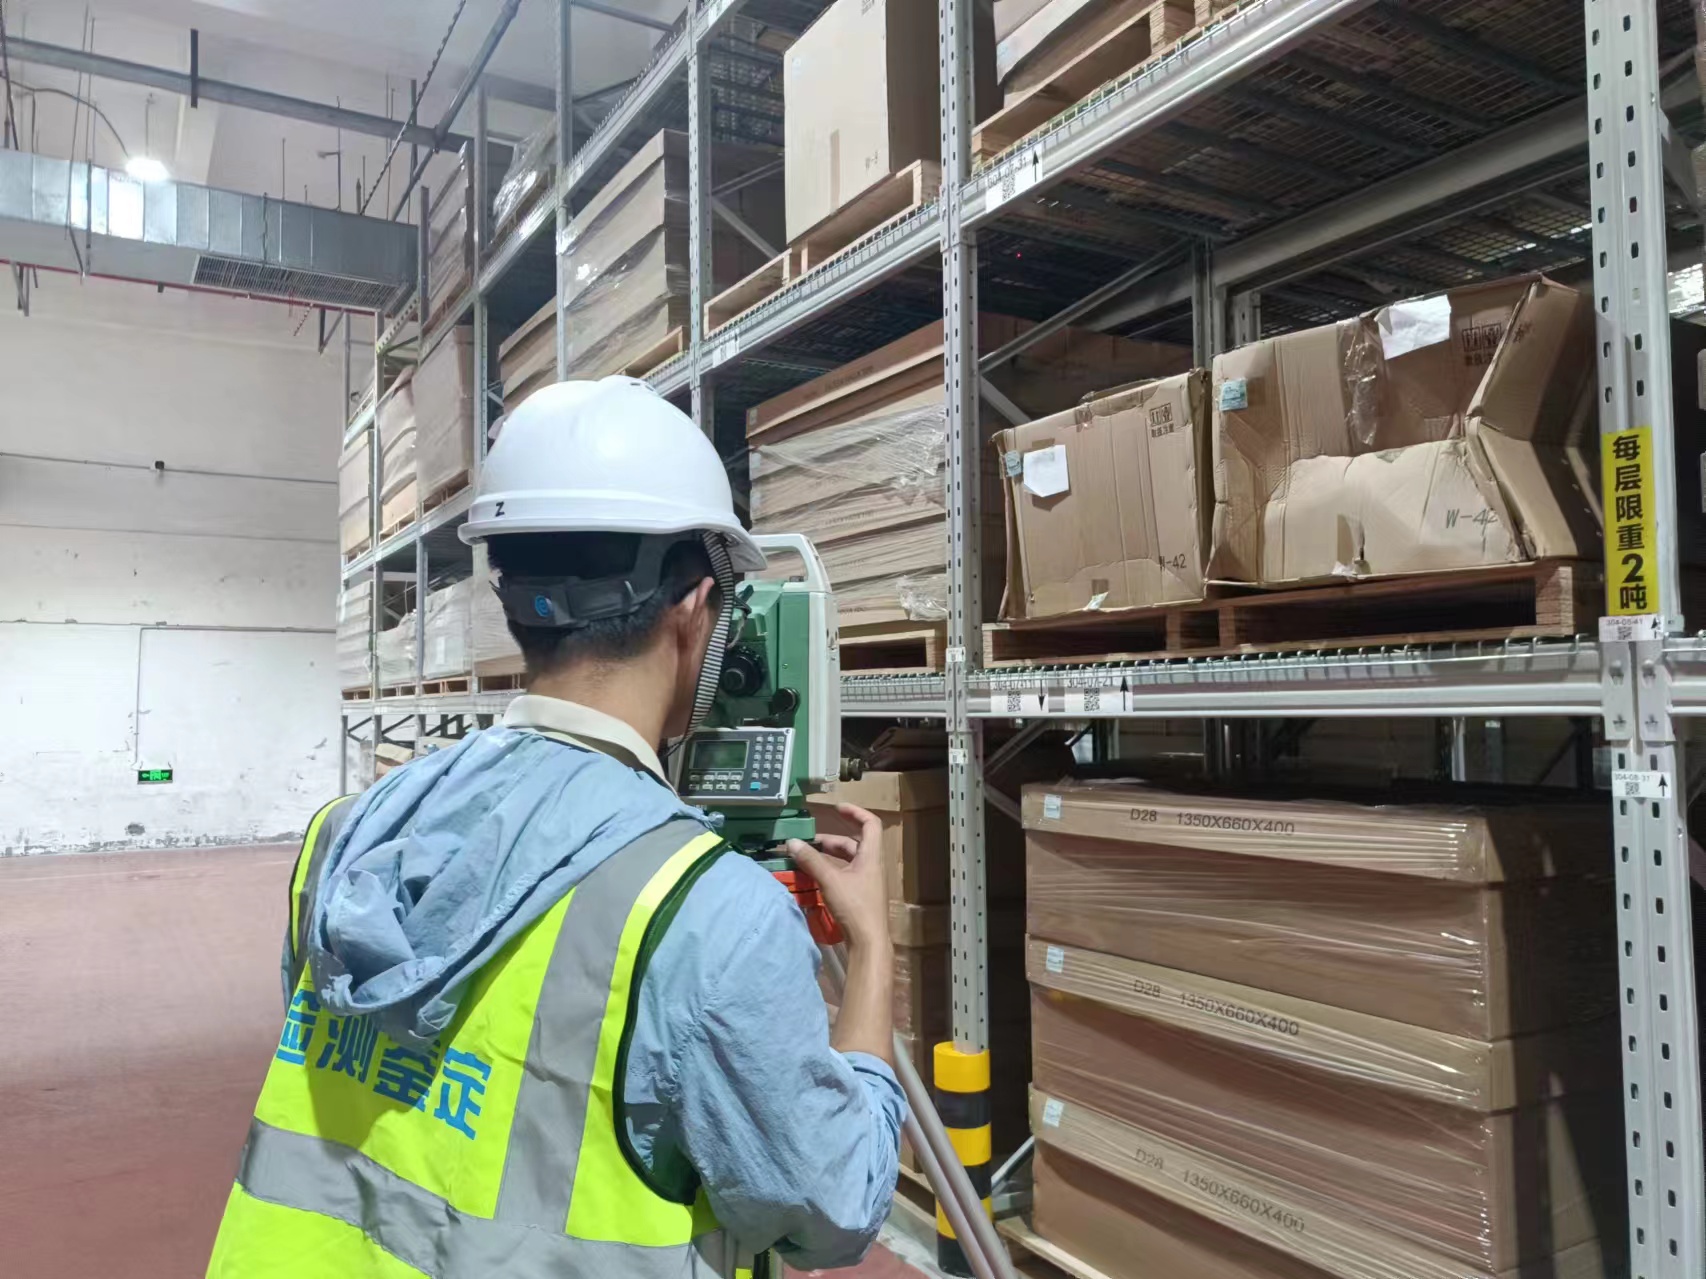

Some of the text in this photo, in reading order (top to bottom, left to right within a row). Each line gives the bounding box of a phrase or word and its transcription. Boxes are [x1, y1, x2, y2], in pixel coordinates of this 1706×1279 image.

[495, 501, 505, 517] Z
[1612, 434, 1648, 611] 每层限重2吨
[1130, 808, 1295, 836] D28 1350X660X400
[1133, 979, 1300, 1036] D28 1350X660X400
[1182, 1168, 1306, 1233] 1350X660X400
